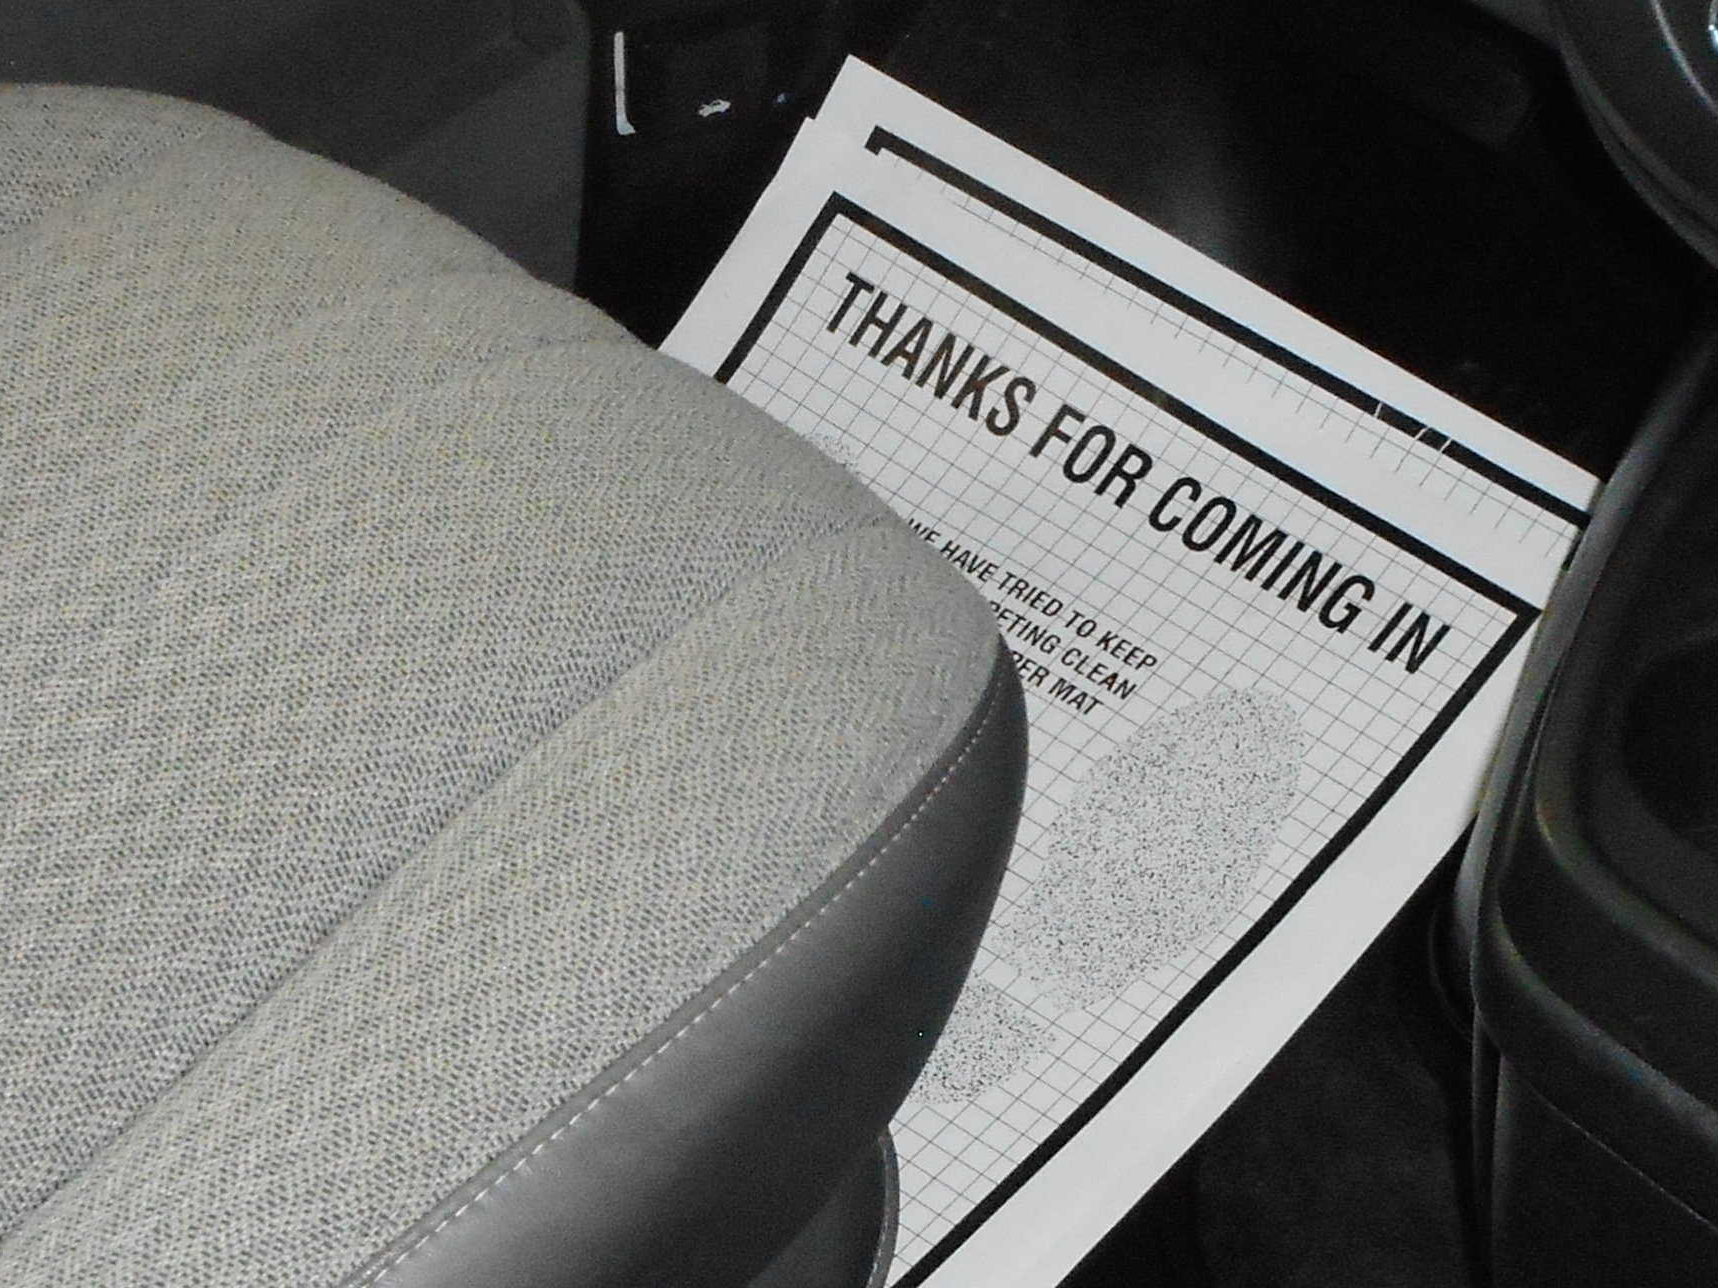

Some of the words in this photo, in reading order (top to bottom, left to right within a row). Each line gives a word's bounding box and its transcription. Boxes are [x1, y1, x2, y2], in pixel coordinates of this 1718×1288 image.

[825, 271, 1038, 438] THANKS
[1027, 402, 1154, 510] FOR
[1147, 476, 1376, 635] COMING
[1366, 600, 1452, 675] IN
[939, 539, 1000, 584] HAVE
[997, 570, 1064, 619] TRIED
[1064, 609, 1098, 638] TO
[1095, 629, 1159, 673] KEEP
[1047, 676, 1104, 716] MAT
[1060, 646, 1138, 702] CLEAN
